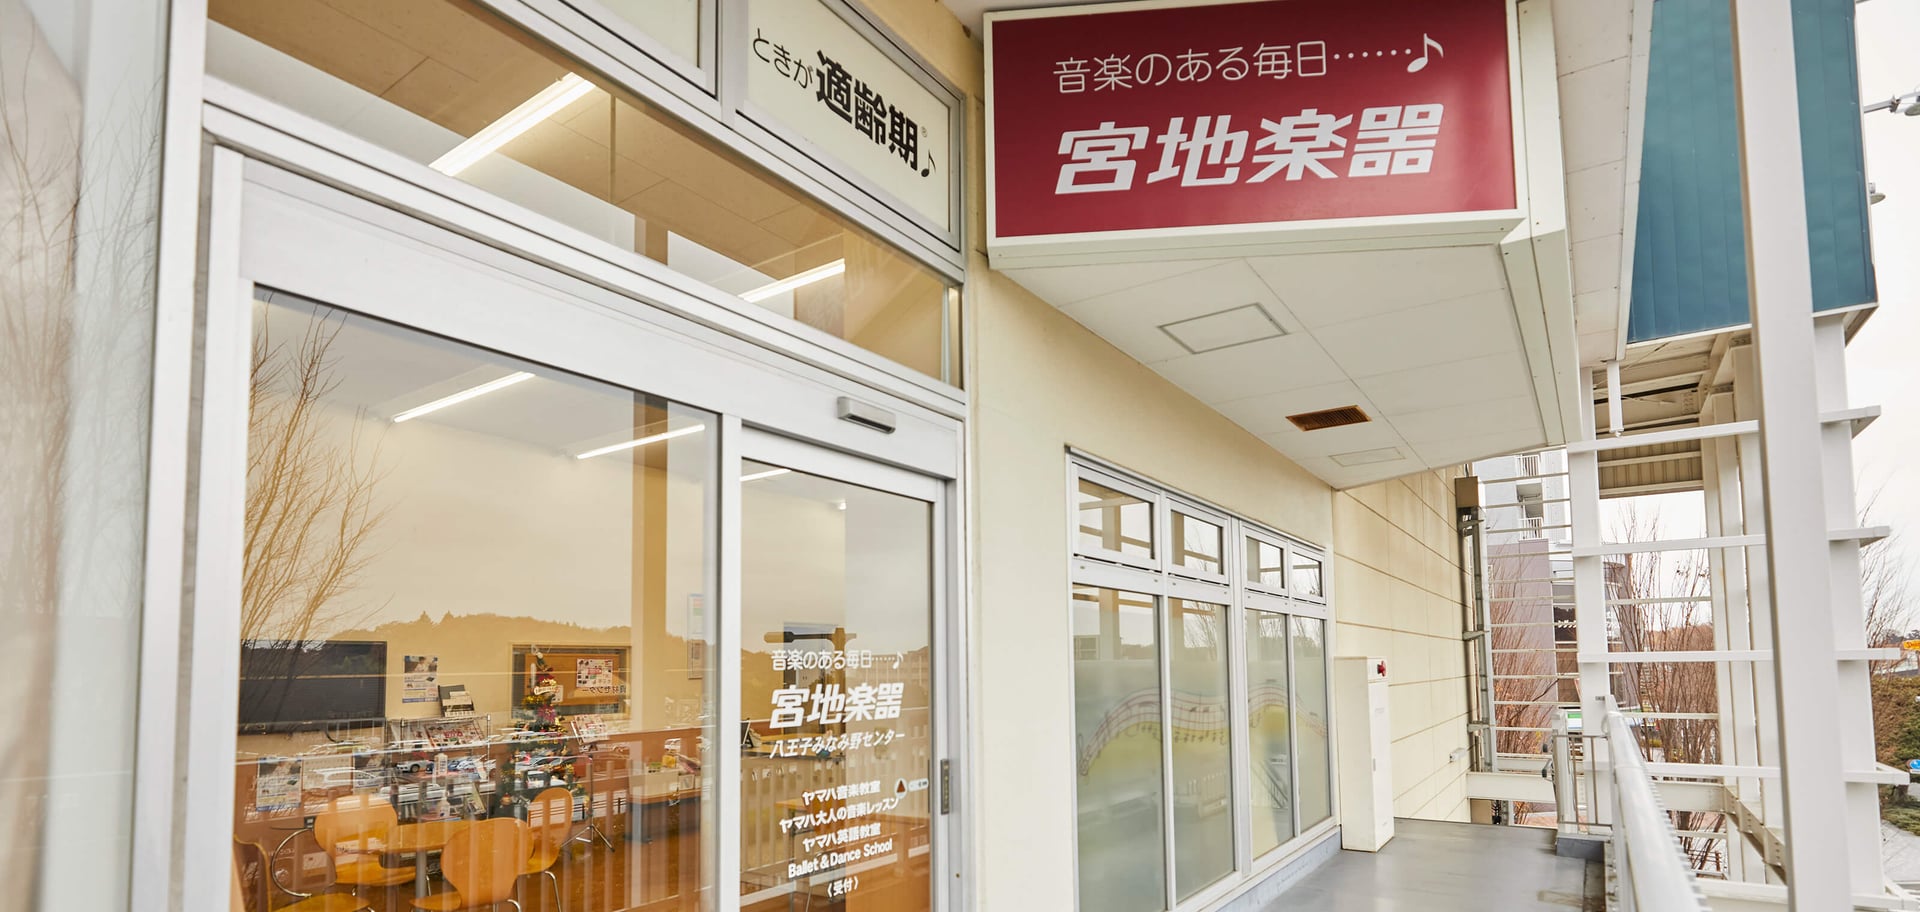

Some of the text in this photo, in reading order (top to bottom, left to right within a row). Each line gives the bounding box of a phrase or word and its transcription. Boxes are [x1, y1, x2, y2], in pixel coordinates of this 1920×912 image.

[1055, 103, 1443, 195] 宮地楽器
[769, 682, 904, 729] 宮地楽器
[769, 729, 905, 759] 八王子みなみ野センター
[802, 780, 880, 805] ヤマハ音楽教室
[779, 797, 899, 833] ヤマハ大人の音楽レッスン
[802, 822, 881, 852] ヤマハ英語教室
[788, 858, 819, 878] Ballet
[830, 849, 861, 866] Dance
[863, 838, 893, 857] School
